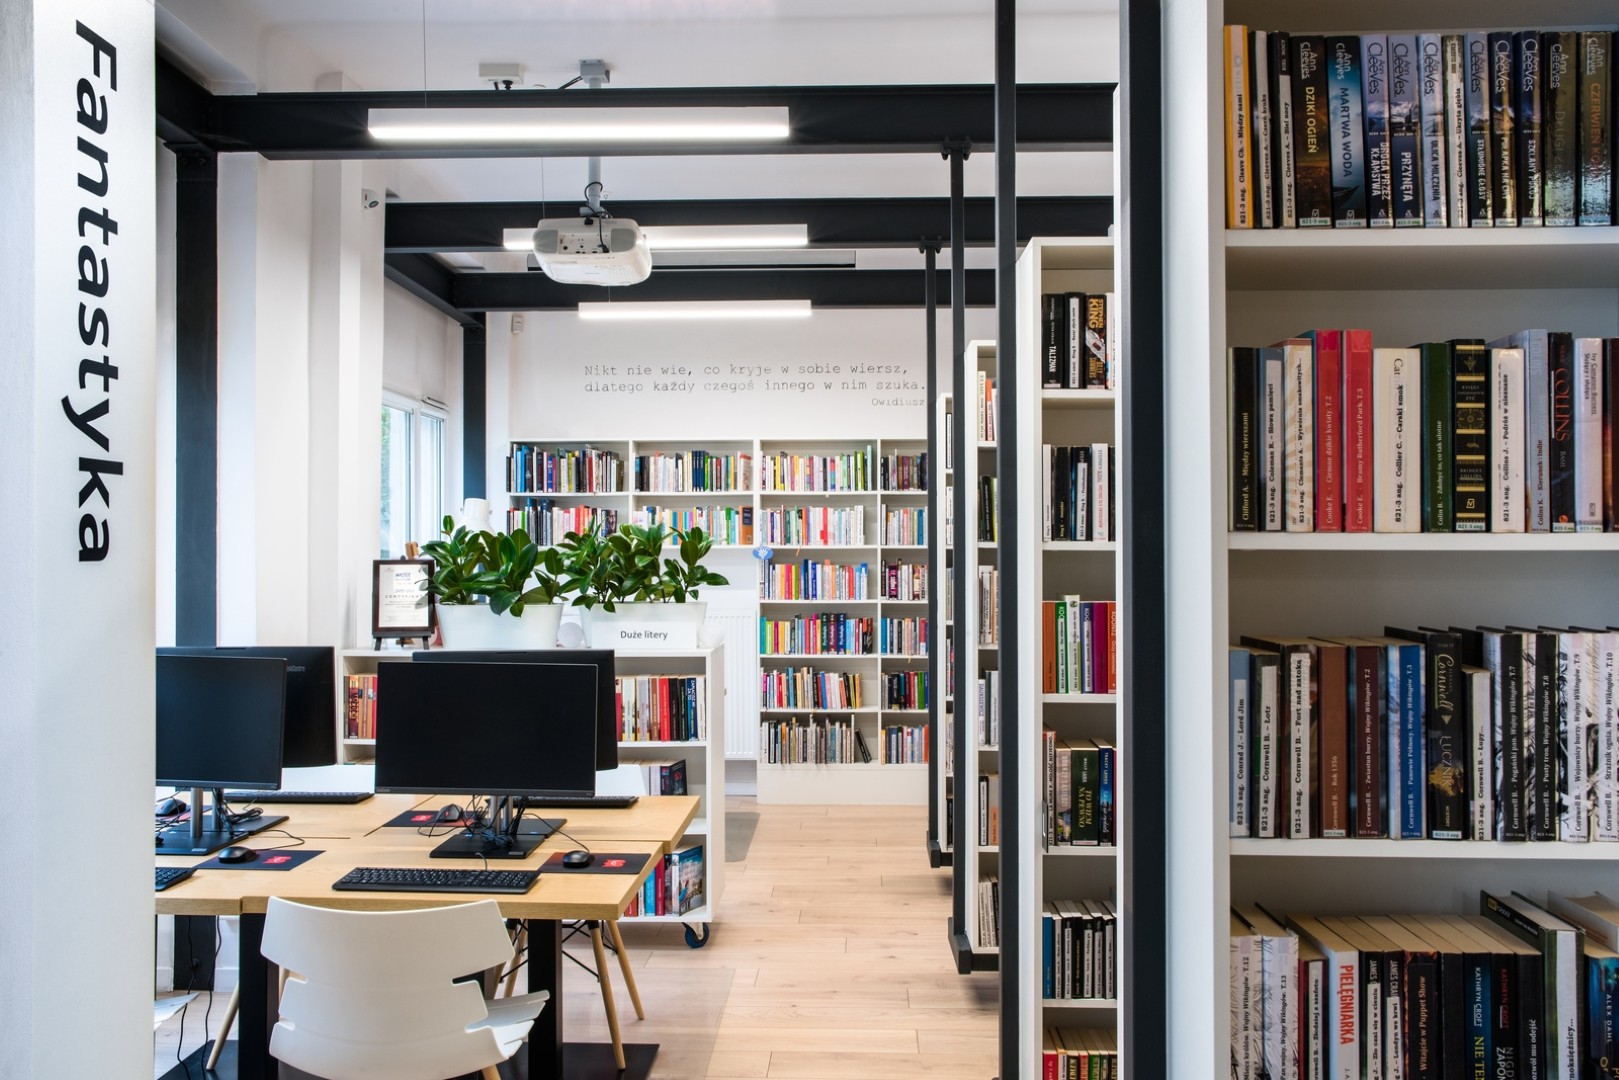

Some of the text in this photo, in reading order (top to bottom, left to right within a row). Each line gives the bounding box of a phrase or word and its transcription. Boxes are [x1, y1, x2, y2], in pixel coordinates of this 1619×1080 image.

[1302, 42, 1311, 79] Cleeves
[1309, 52, 1318, 70] Ann
[1335, 42, 1345, 80] Cleeves
[1344, 52, 1352, 72] Ann
[1368, 42, 1383, 94] Cleeves
[1394, 42, 1408, 96] Cleeves
[1423, 42, 1440, 95] Cleeves
[1470, 40, 1484, 93] Cleeves
[1495, 40, 1510, 93] Cleeves
[1523, 38, 1538, 92] Cleeves
[1552, 44, 1562, 88] Cleeves
[1596, 48, 1605, 66] Ann
[1236, 113, 1244, 138] Między
[1306, 86, 1318, 153] DZIKI OGIEŃ
[1340, 88, 1352, 178] MARTWA WODA
[1554, 111, 1566, 152] DŁUGI
[1477, 138, 1486, 200] STŁUMIONE GŁOSY
[1501, 136, 1510, 170] PUŁAPKA
[1528, 139, 1536, 172] SZKLANY
[1370, 148, 1381, 196] KŁAMSTWA
[1380, 142, 1391, 200] DROGA PRZEZ
[1400, 152, 1413, 202] PRZYNĘTA
[1430, 140, 1441, 200] ULICA MILCZENIA
[62, 19, 124, 562] Fantastyka
[1089, 298, 1099, 328] KING
[584, 363, 908, 378] Nikt nie wie, co kryje w sobie wiersz,
[584, 379, 926, 394] dlatego każdy czegoś innego w nim szuka.
[871, 397, 925, 406] Owidiusz
[1555, 368, 1570, 442] COLLINS
[1326, 408, 1334, 434] kwiaty.
[1242, 451, 1250, 476] Między
[620, 630, 669, 642] Duże litery
[1438, 654, 1454, 711] Cornwell
[1510, 680, 1518, 713] Wikingów
[1574, 668, 1582, 700] Wikingów
[1606, 672, 1614, 704] Wikingów
[1542, 690, 1550, 723] Wikingów
[1574, 702, 1582, 722] Wojny
[1605, 708, 1613, 728] Wojny
[1510, 714, 1518, 735] Wojny
[1574, 724, 1582, 746] burzy.
[1440, 736, 1452, 786] ŁUCZNIK
[1510, 752, 1518, 782] Pogański
[1574, 748, 1582, 782] Wojownicy
[1086, 790, 1092, 800] TO
[1370, 960, 1378, 980] JAMES
[1390, 960, 1398, 980] JAMES
[1337, 965, 1354, 1044] PIELĘGNIARKA
[1418, 976, 1428, 1070] Witajcie Puppet Show
[1529, 1019, 1538, 1043] odejść
[1474, 1036, 1484, 1057] NIE
